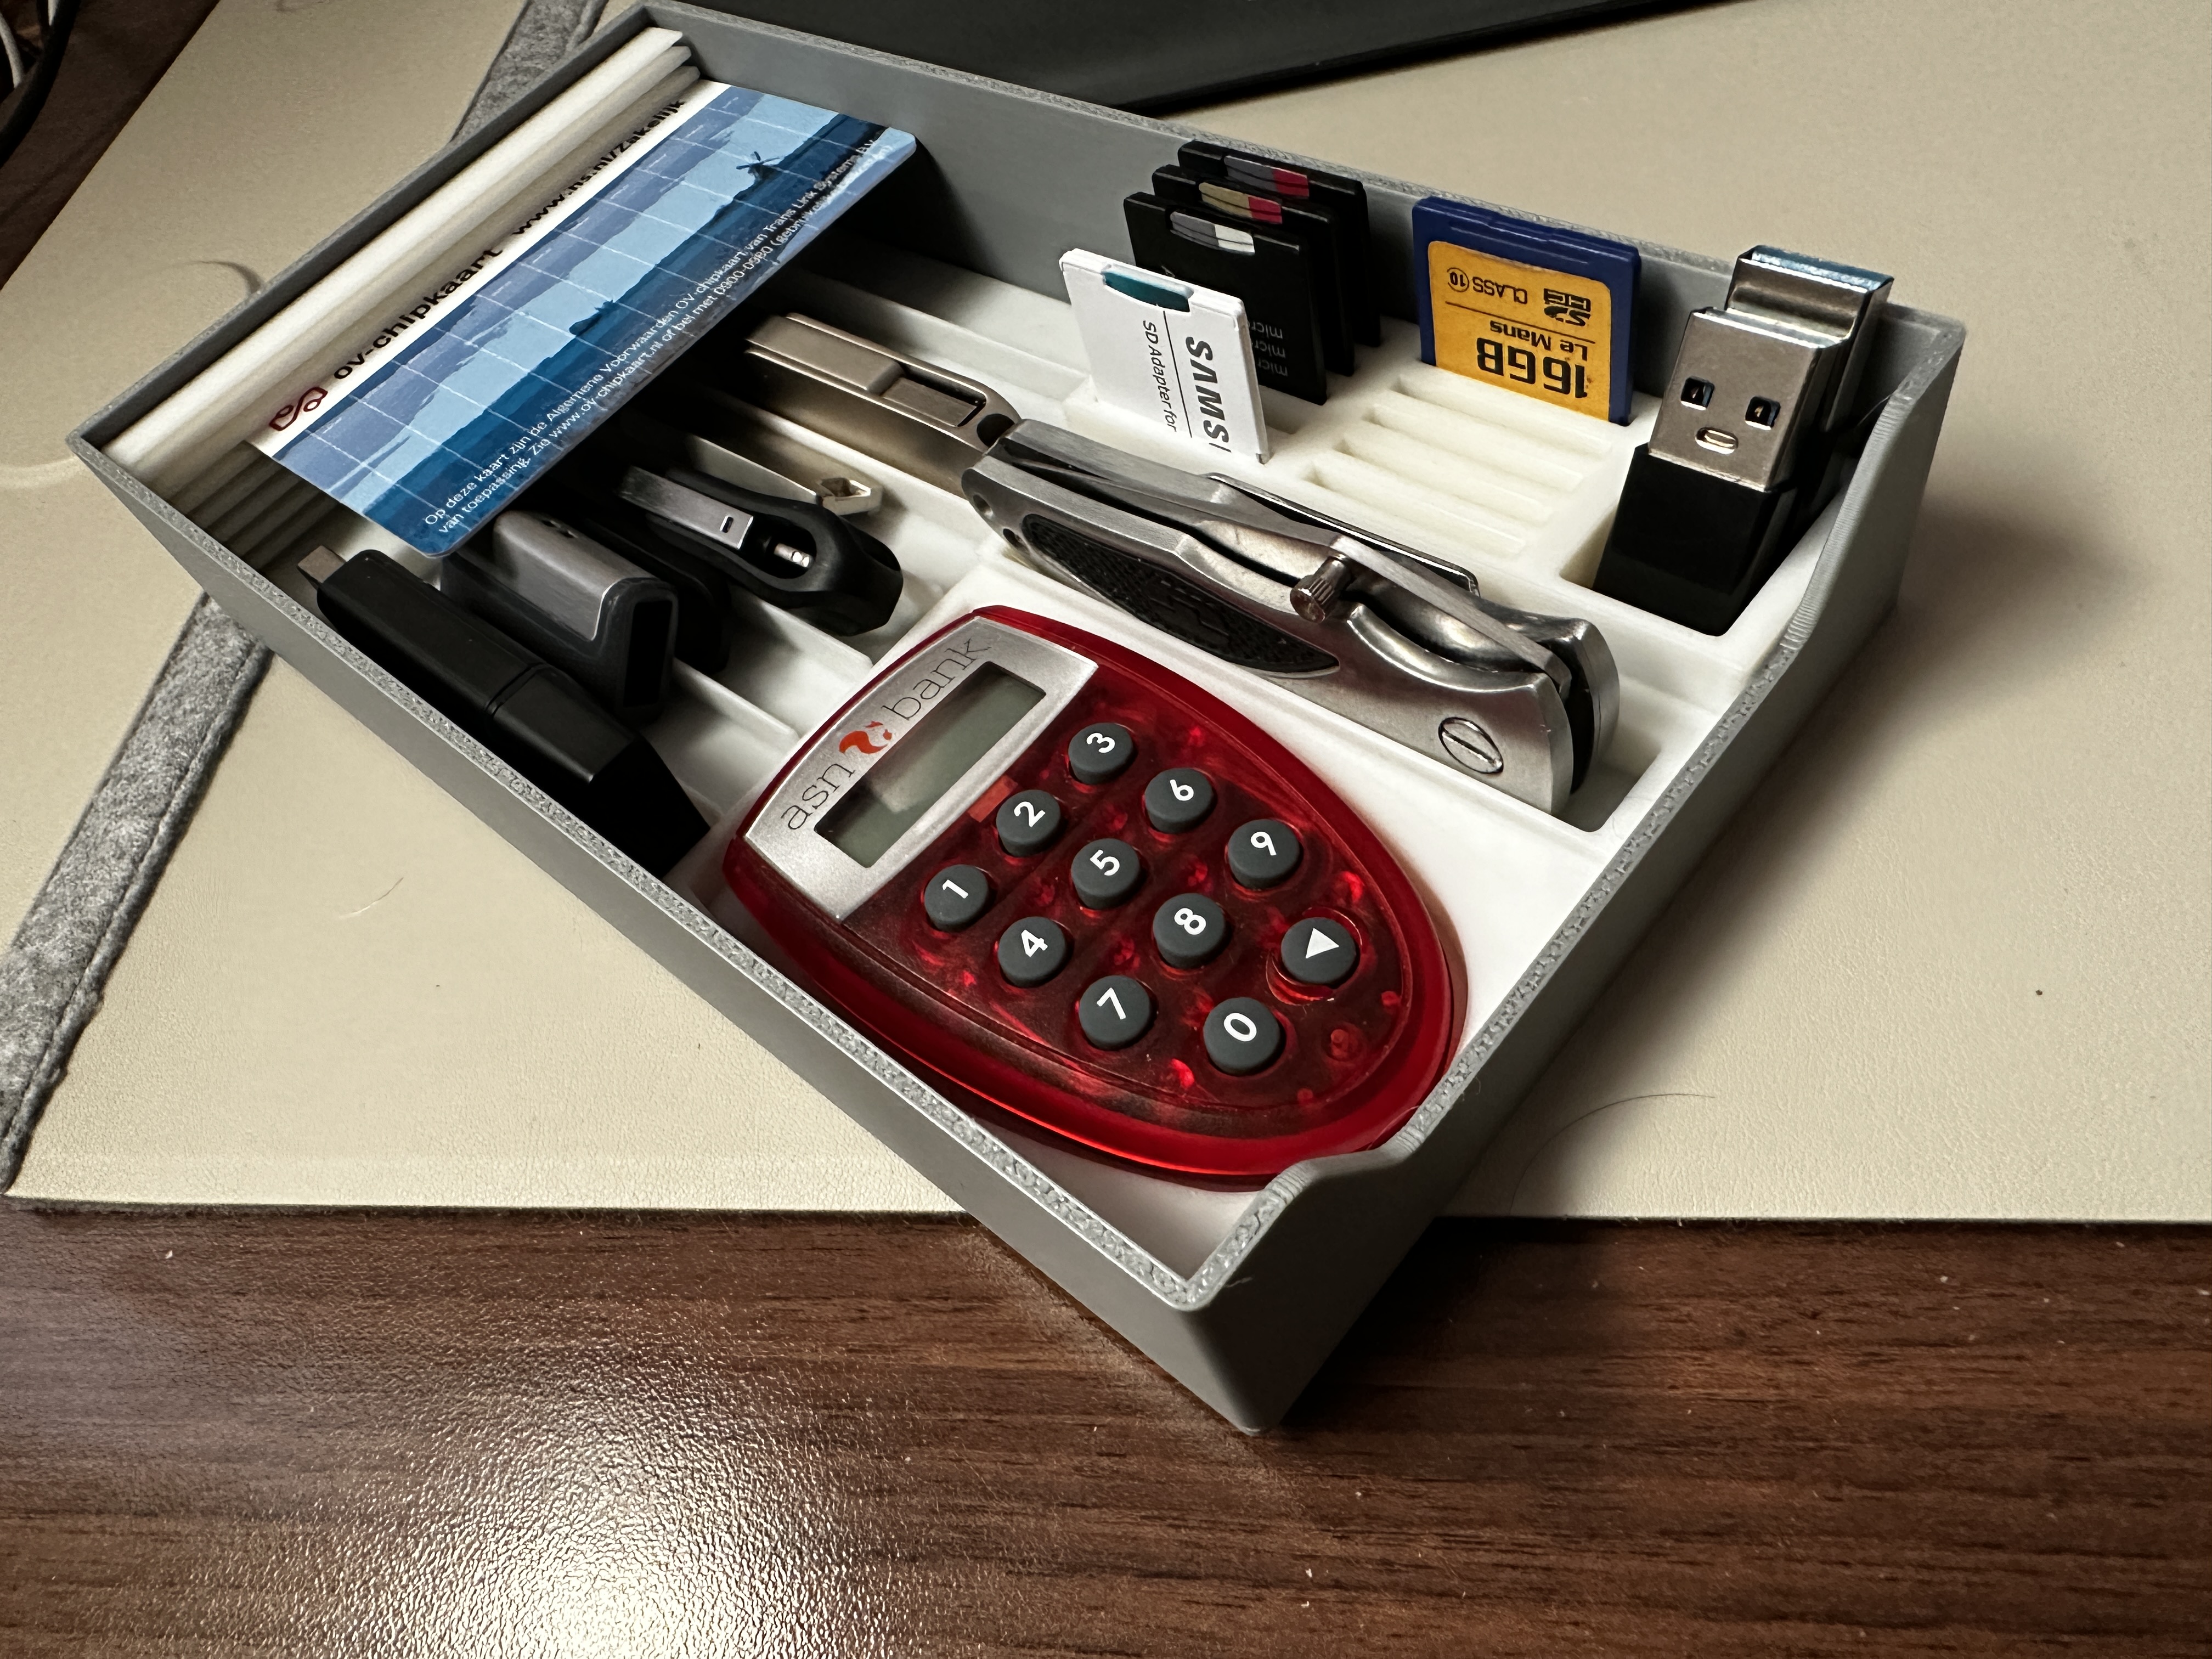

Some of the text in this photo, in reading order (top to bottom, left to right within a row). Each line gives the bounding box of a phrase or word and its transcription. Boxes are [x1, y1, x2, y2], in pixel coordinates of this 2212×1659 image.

[1472, 276, 1527, 304] CLASS
[334, 249, 503, 379] ov-chipkaart
[1248, 321, 1283, 339] micr
[1489, 320, 1588, 362] Le Mans
[1251, 340, 1286, 358] micr
[425, 509, 446, 524] Op
[445, 482, 478, 508] deze
[474, 454, 510, 482] kaart
[509, 436, 532, 455] zijn
[529, 421, 548, 436] de
[546, 373, 604, 422] Algemene
[600, 310, 679, 372] Voorwaarden
[745, 233, 768, 251] van
[763, 208, 796, 233] Trans
[1143, 320, 1177, 432] SD Adapter for
[1257, 358, 1288, 376] micr
[1476, 337, 1588, 398] 16GB
[1186, 336, 1232, 453] SAMS
[438, 512, 465, 533] van
[671, 313, 696, 332] bel
[692, 295, 718, 315] met
[781, 637, 992, 831] asn bank
[1086, 732, 1115, 754] 3
[1170, 779, 1195, 802] 6
[1013, 800, 1046, 827] 2
[1250, 831, 1277, 856] 9
[1089, 849, 1120, 877] 5
[942, 879, 969, 900] 1
[1173, 907, 1207, 935] 8
[1021, 929, 1049, 957] 4
[1096, 986, 1127, 1020] 7
[1223, 1012, 1257, 1042] 0
